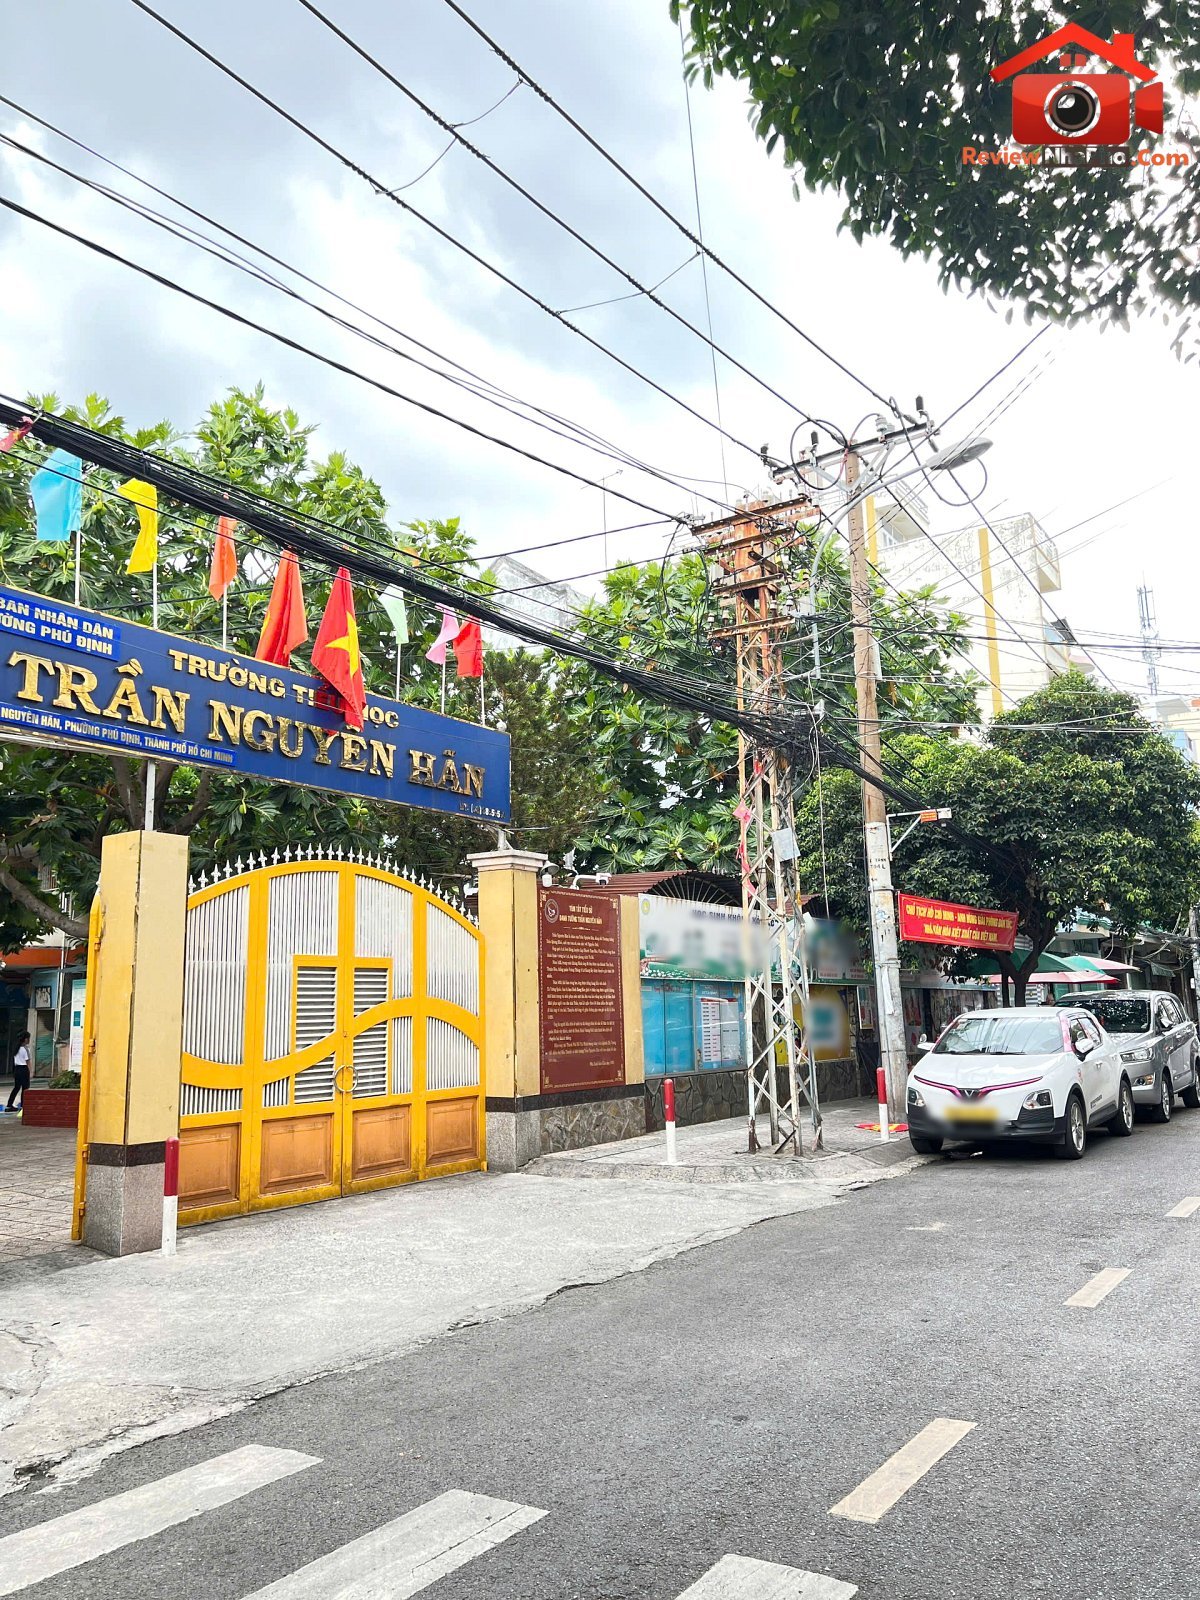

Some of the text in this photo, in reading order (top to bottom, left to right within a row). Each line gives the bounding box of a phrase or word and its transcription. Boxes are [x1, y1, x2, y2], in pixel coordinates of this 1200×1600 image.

[35, 608, 78, 630] NHÂN
[83, 621, 113, 640] DÂN
[41, 625, 72, 643] PHÚ
[76, 635, 112, 655] ĐỊNH
[169, 649, 285, 698] TRƯỜNG
[8, 651, 190, 734] TRẦN
[409, 749, 486, 798] HÃN
[65, 720, 100, 737] PHƯỜNG
[102, 728, 119, 740] PHÚ
[120, 731, 142, 745] ĐỊNH,
[144, 736, 170, 750] THÀNH
[214, 751, 233, 763] MINH
